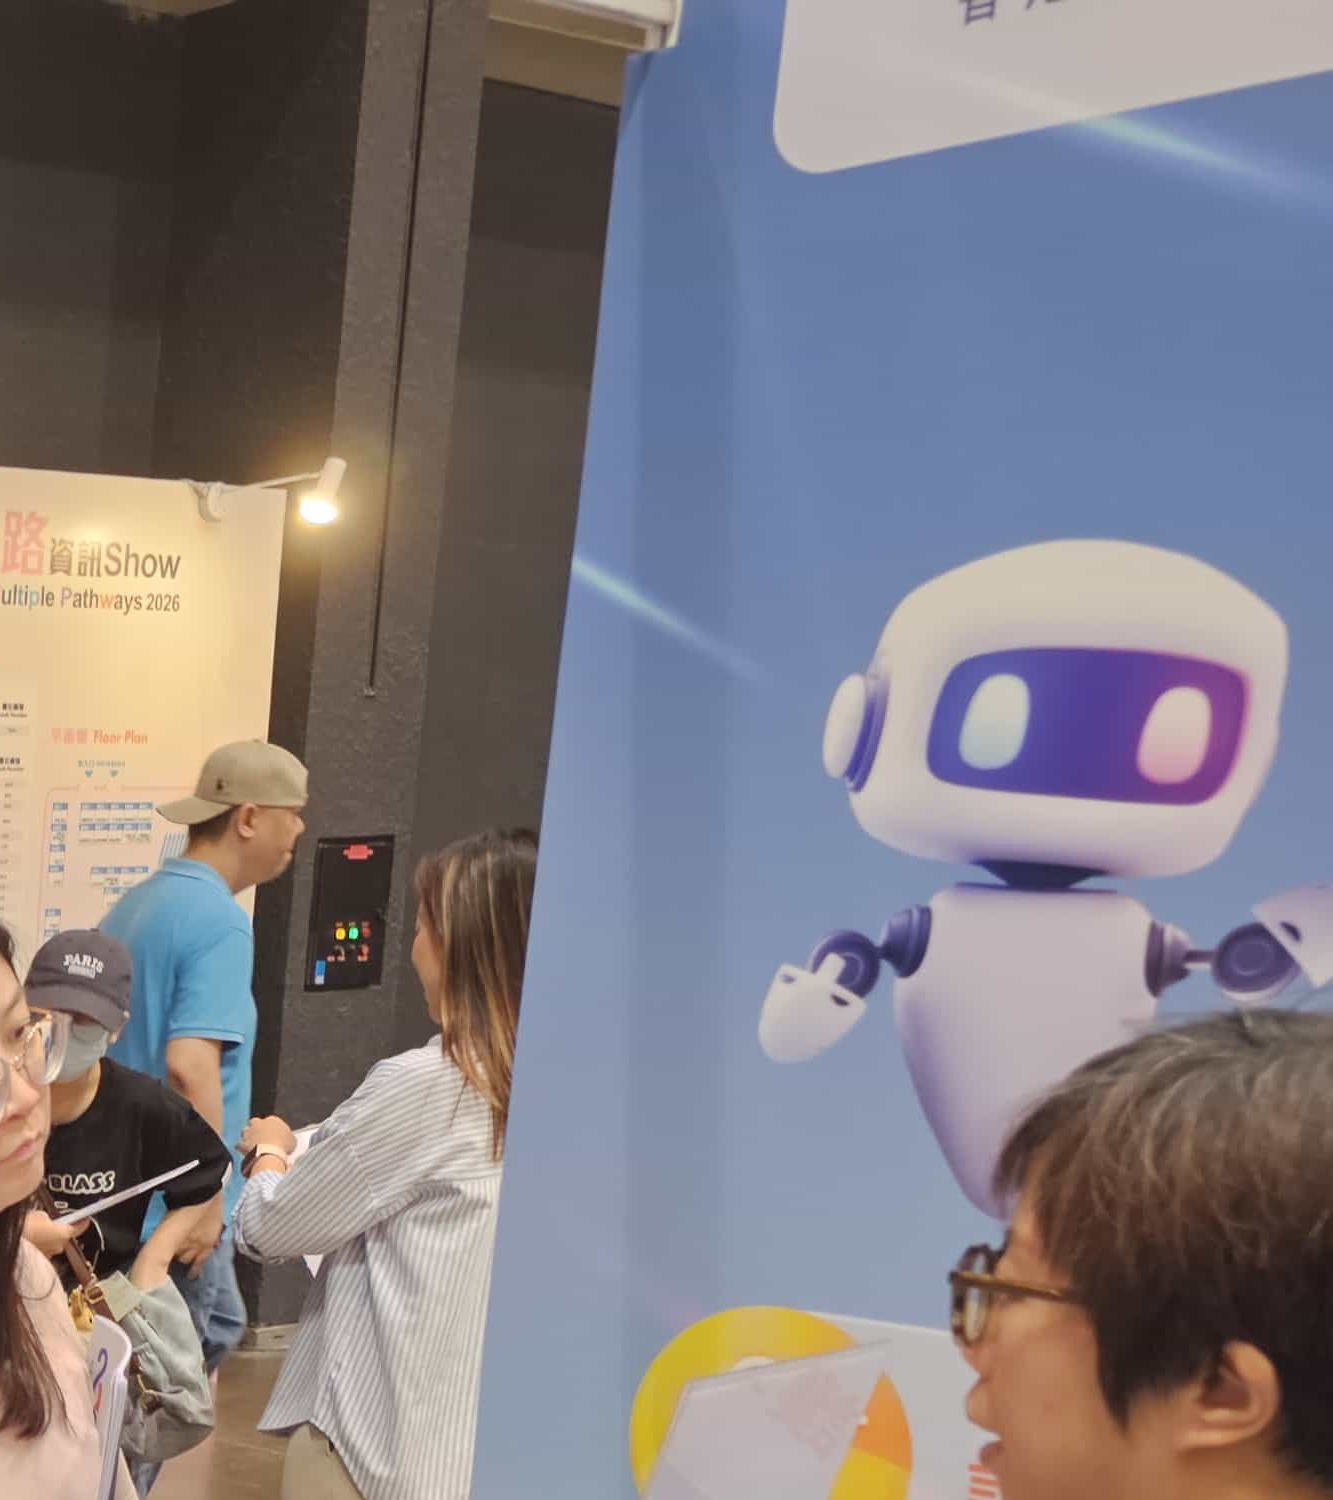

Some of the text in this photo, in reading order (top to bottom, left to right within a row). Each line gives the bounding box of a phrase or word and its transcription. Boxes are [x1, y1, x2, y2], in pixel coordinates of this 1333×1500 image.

[60, 587, 143, 617] Pathways
[146, 593, 181, 613] 2026
[93, 729, 123, 744] Floor
[124, 730, 149, 745] Plan
[63, 953, 104, 974] PARIS
